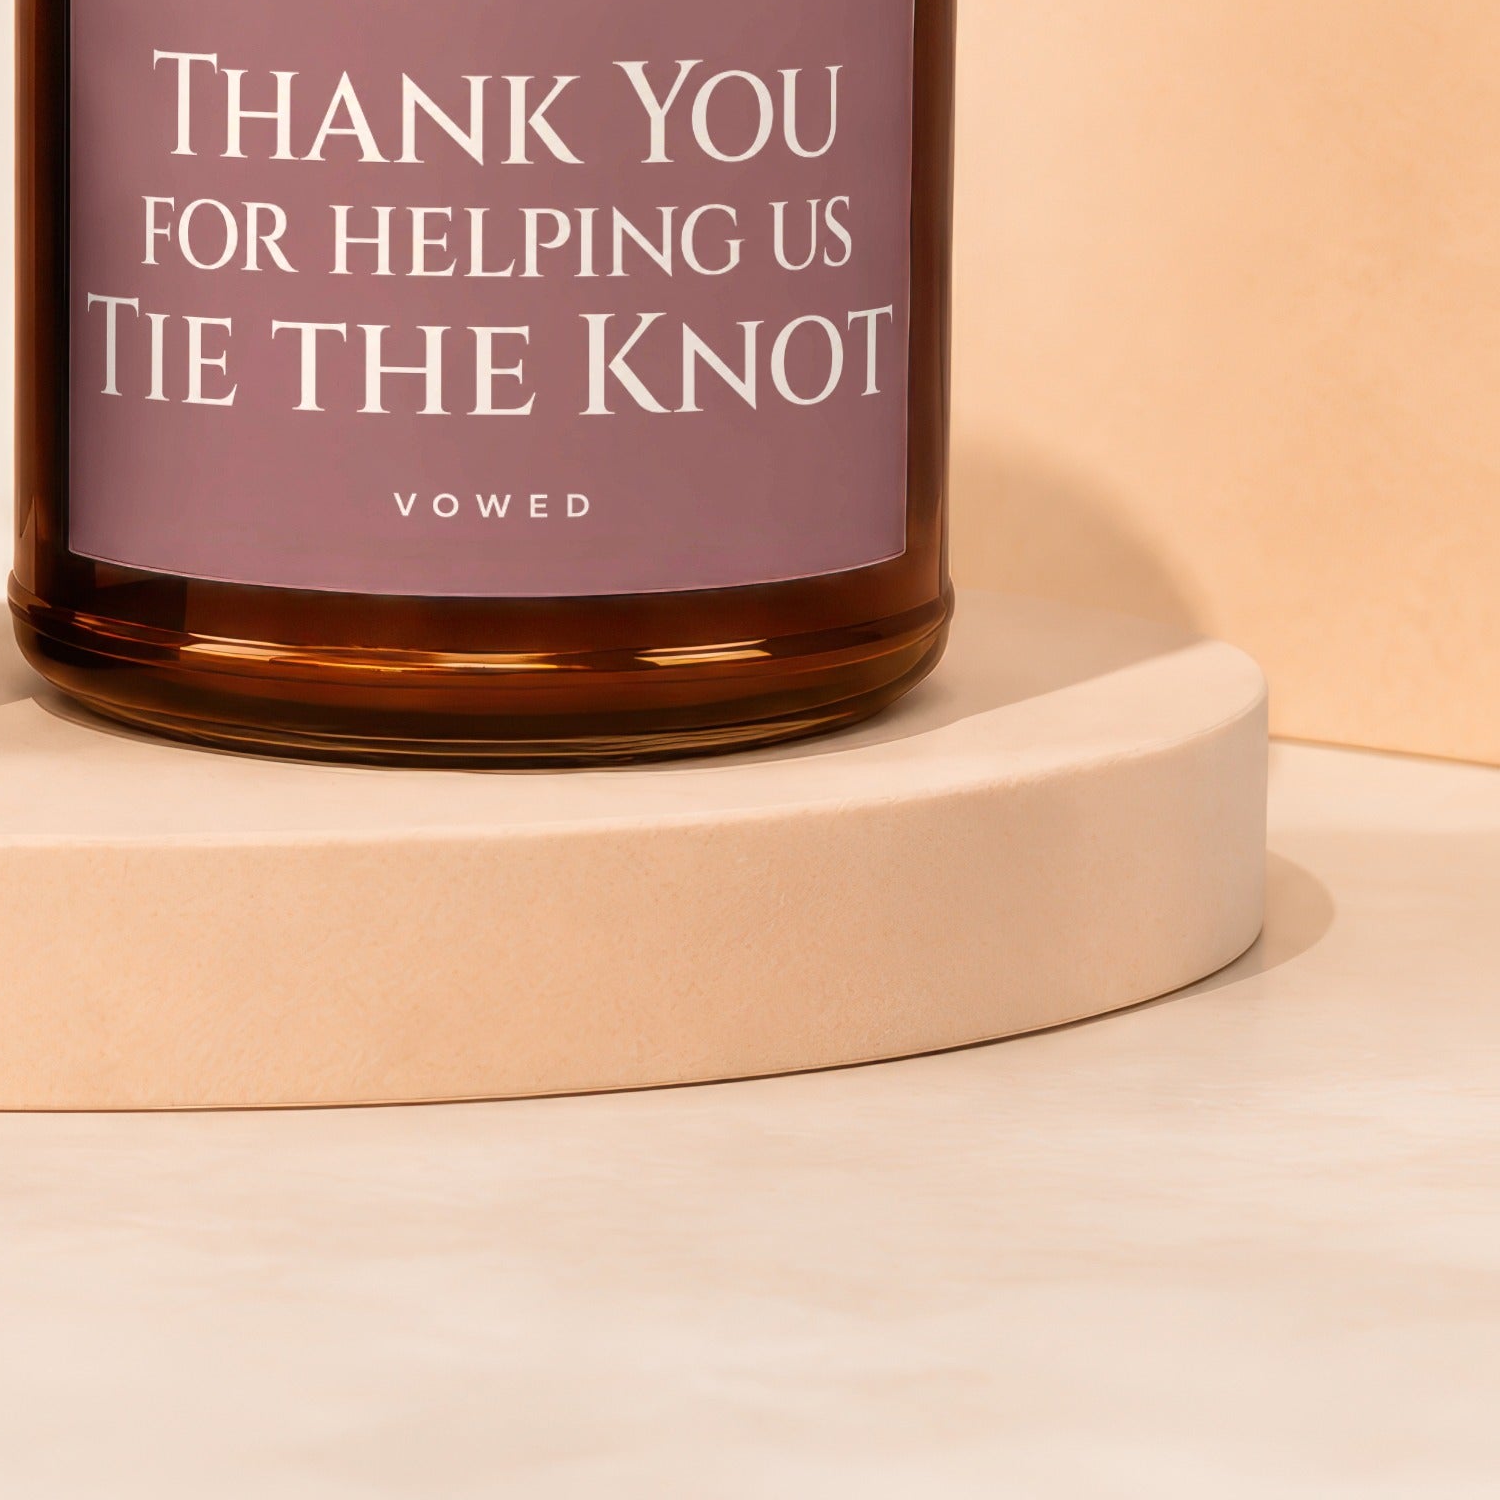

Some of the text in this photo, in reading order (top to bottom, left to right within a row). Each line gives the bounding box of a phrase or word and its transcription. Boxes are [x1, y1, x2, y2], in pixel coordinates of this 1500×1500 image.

[154, 49, 843, 166] THANK YOU
[141, 196, 852, 277] FOR HELPING US
[88, 292, 892, 415] TIE THE KNOT
[394, 493, 589, 518] VOWED
